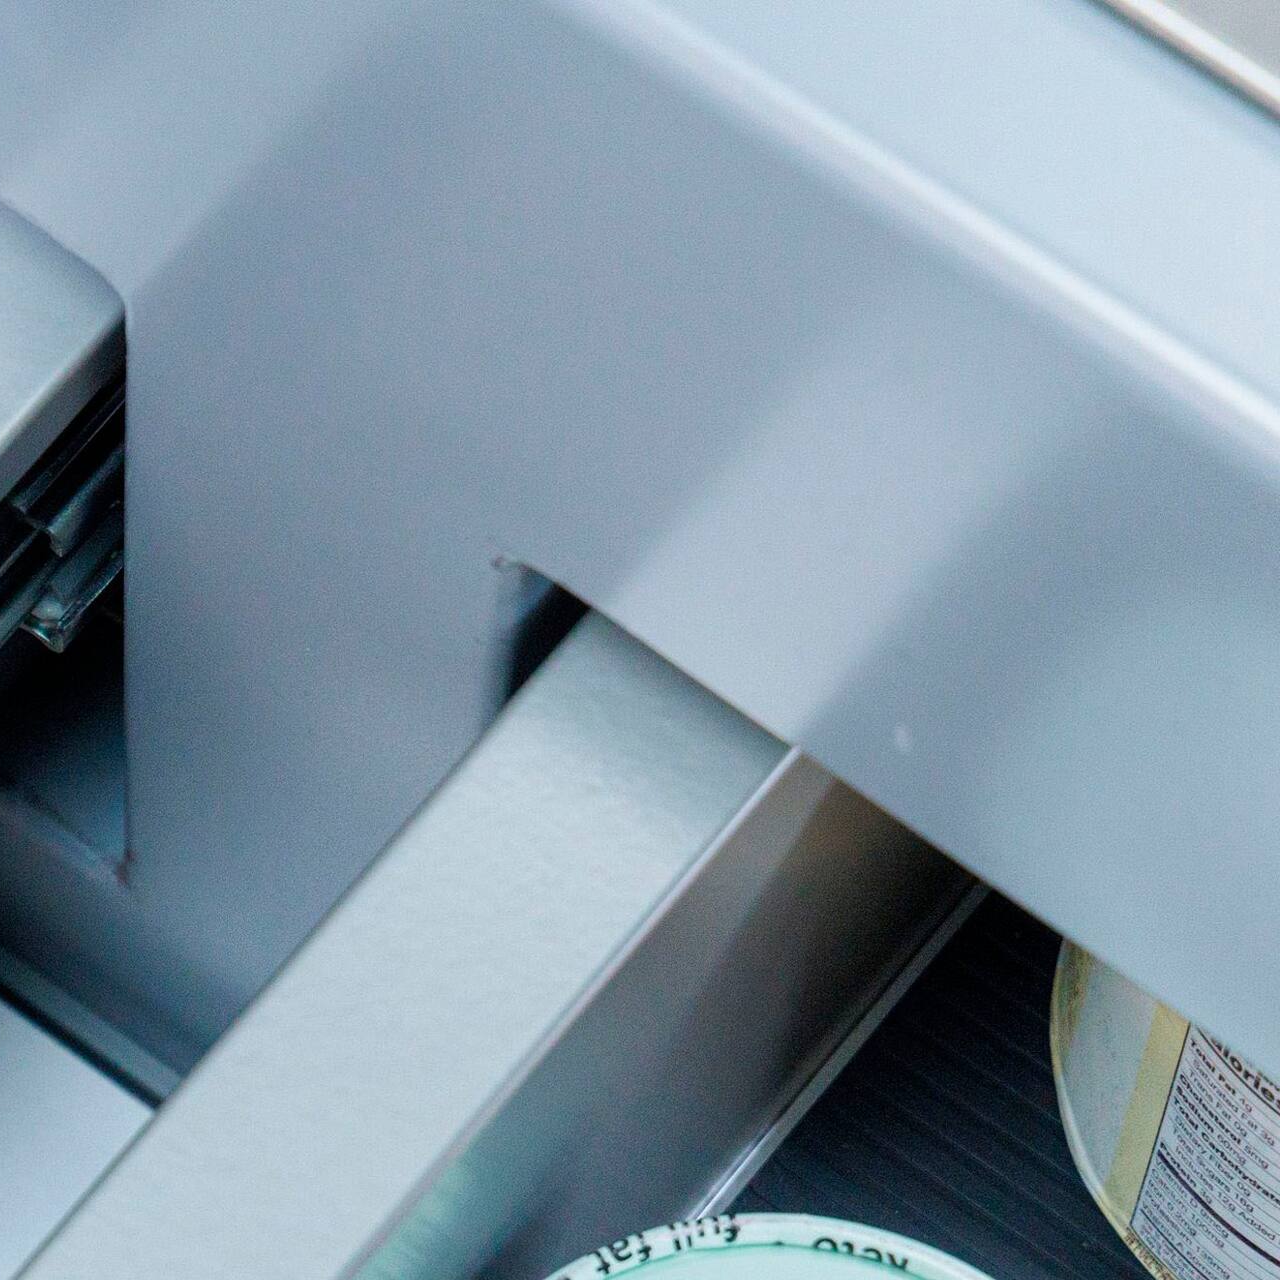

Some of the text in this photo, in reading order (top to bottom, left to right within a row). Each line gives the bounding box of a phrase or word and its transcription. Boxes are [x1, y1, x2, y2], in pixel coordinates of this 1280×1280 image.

[1188, 1069, 1214, 1103] Trans
[1215, 1101, 1231, 1121] Fat
[1190, 1039, 1216, 1074] Total
[1218, 1073, 1237, 1097] Fat
[1192, 1058, 1239, 1114] Saturated
[1241, 1111, 1258, 1132] Fat
[1172, 1096, 1199, 1132] Total
[1175, 1084, 1215, 1133] Sodium
[1179, 1073, 1241, 1146] Cholesterol
[1159, 1141, 1197, 1189] Protein
[1172, 1126, 1195, 1156] Total
[1195, 1154, 1231, 1195] Sugars
[1174, 1115, 1208, 1157] Dietary
[1208, 1153, 1234, 1182] Fiber
[1175, 1145, 1214, 1192] Includes
[1238, 1209, 1276, 1243] Added
[588, 1231, 654, 1276] fat
